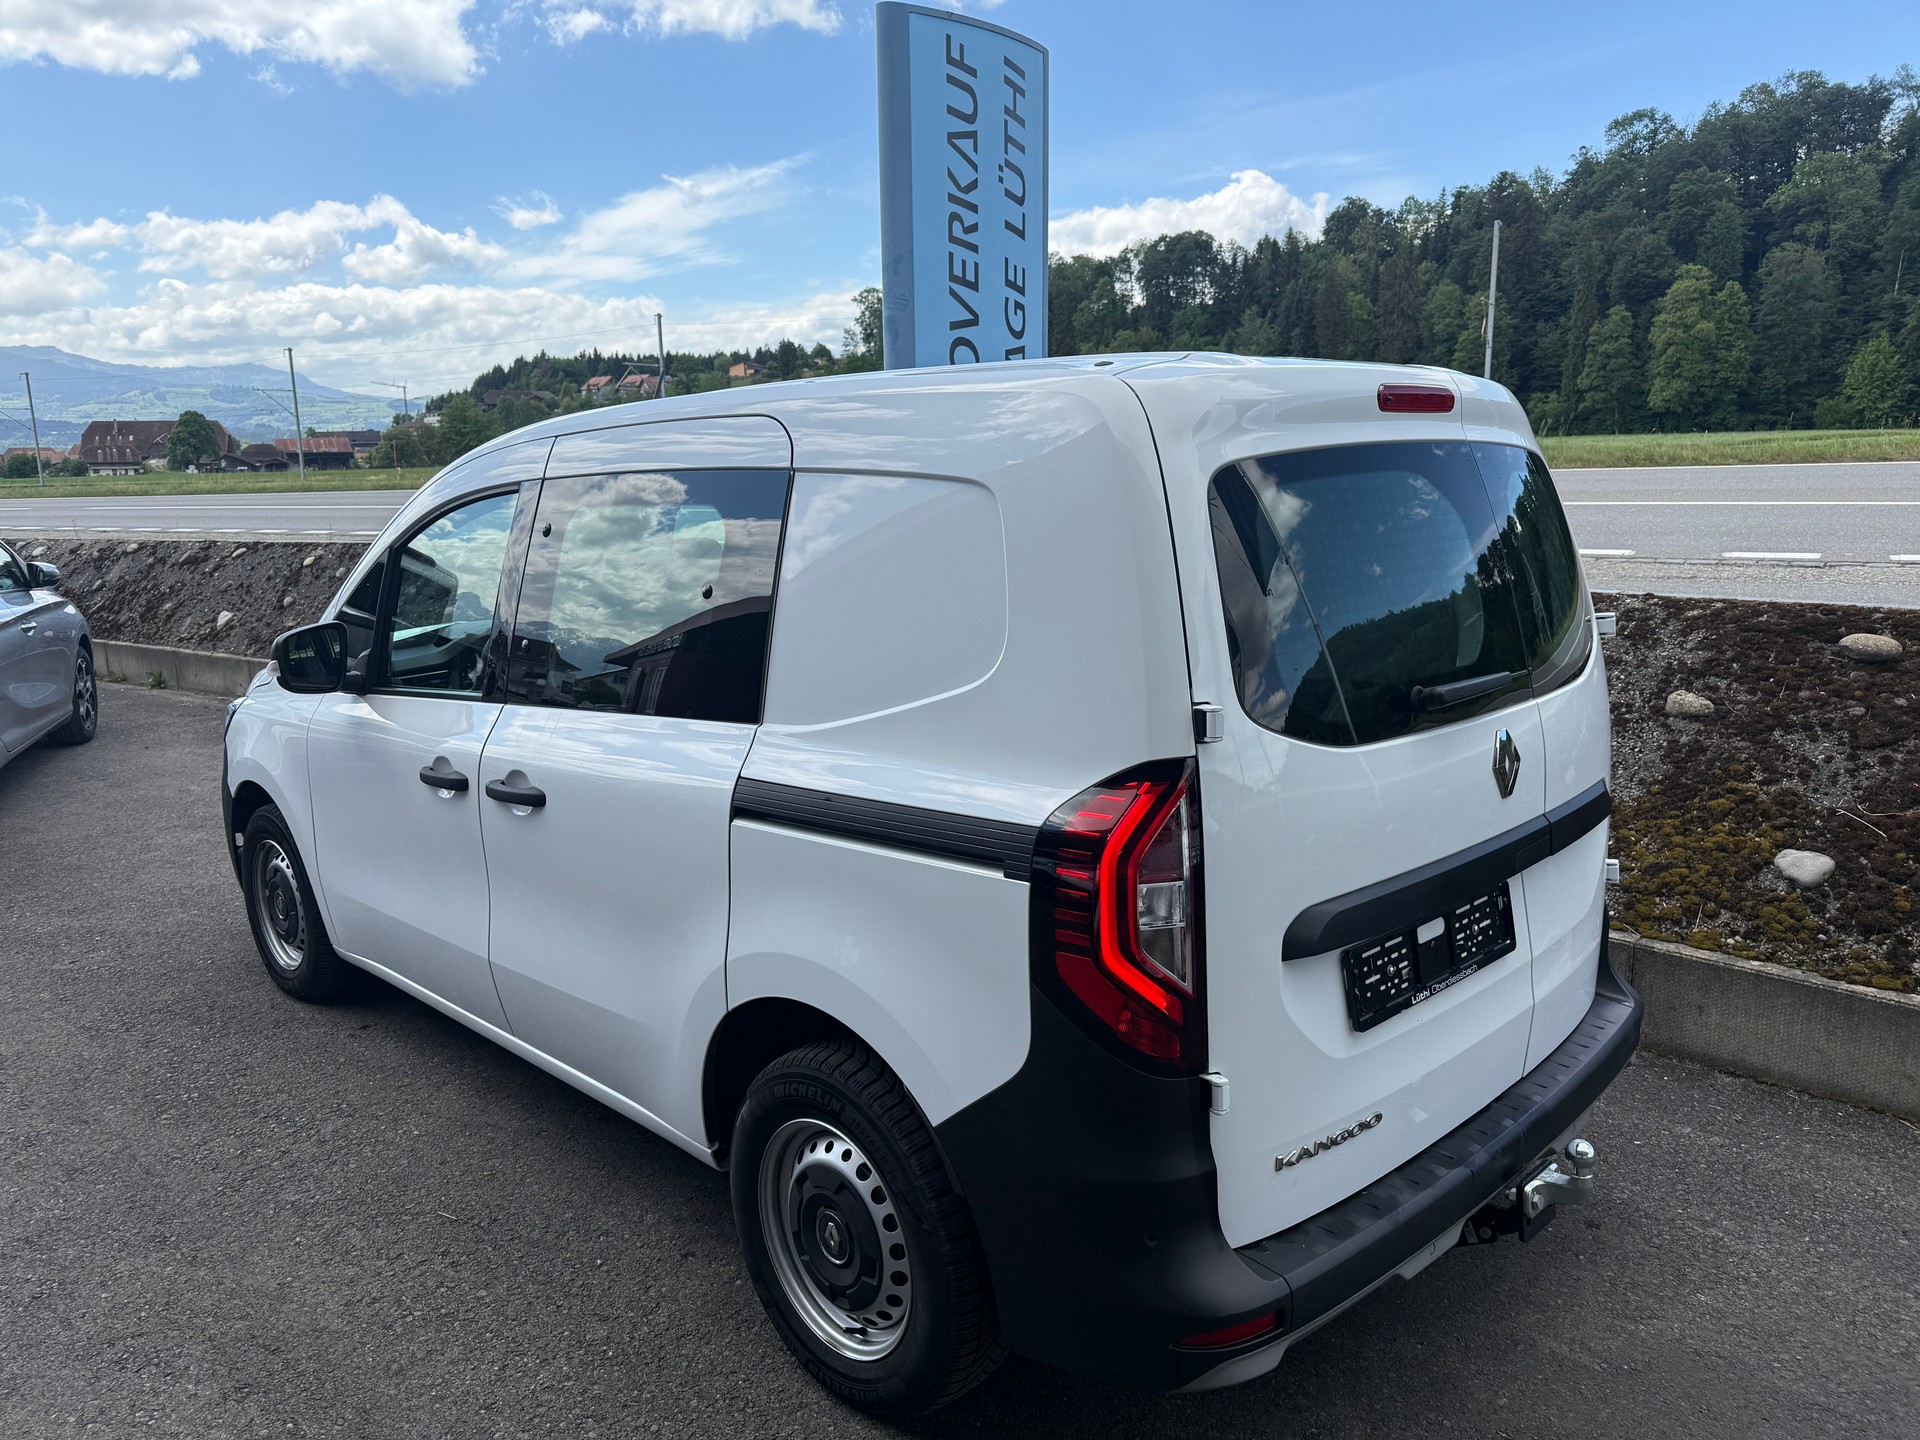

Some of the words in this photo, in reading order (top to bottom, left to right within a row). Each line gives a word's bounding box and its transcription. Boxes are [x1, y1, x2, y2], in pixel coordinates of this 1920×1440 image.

[998, 54, 1026, 242] LÜTHI
[1411, 987, 1431, 1005] Lüthi
[773, 1082, 843, 1115] MICHELIN
[1274, 1110, 1383, 1172] KANGOO
